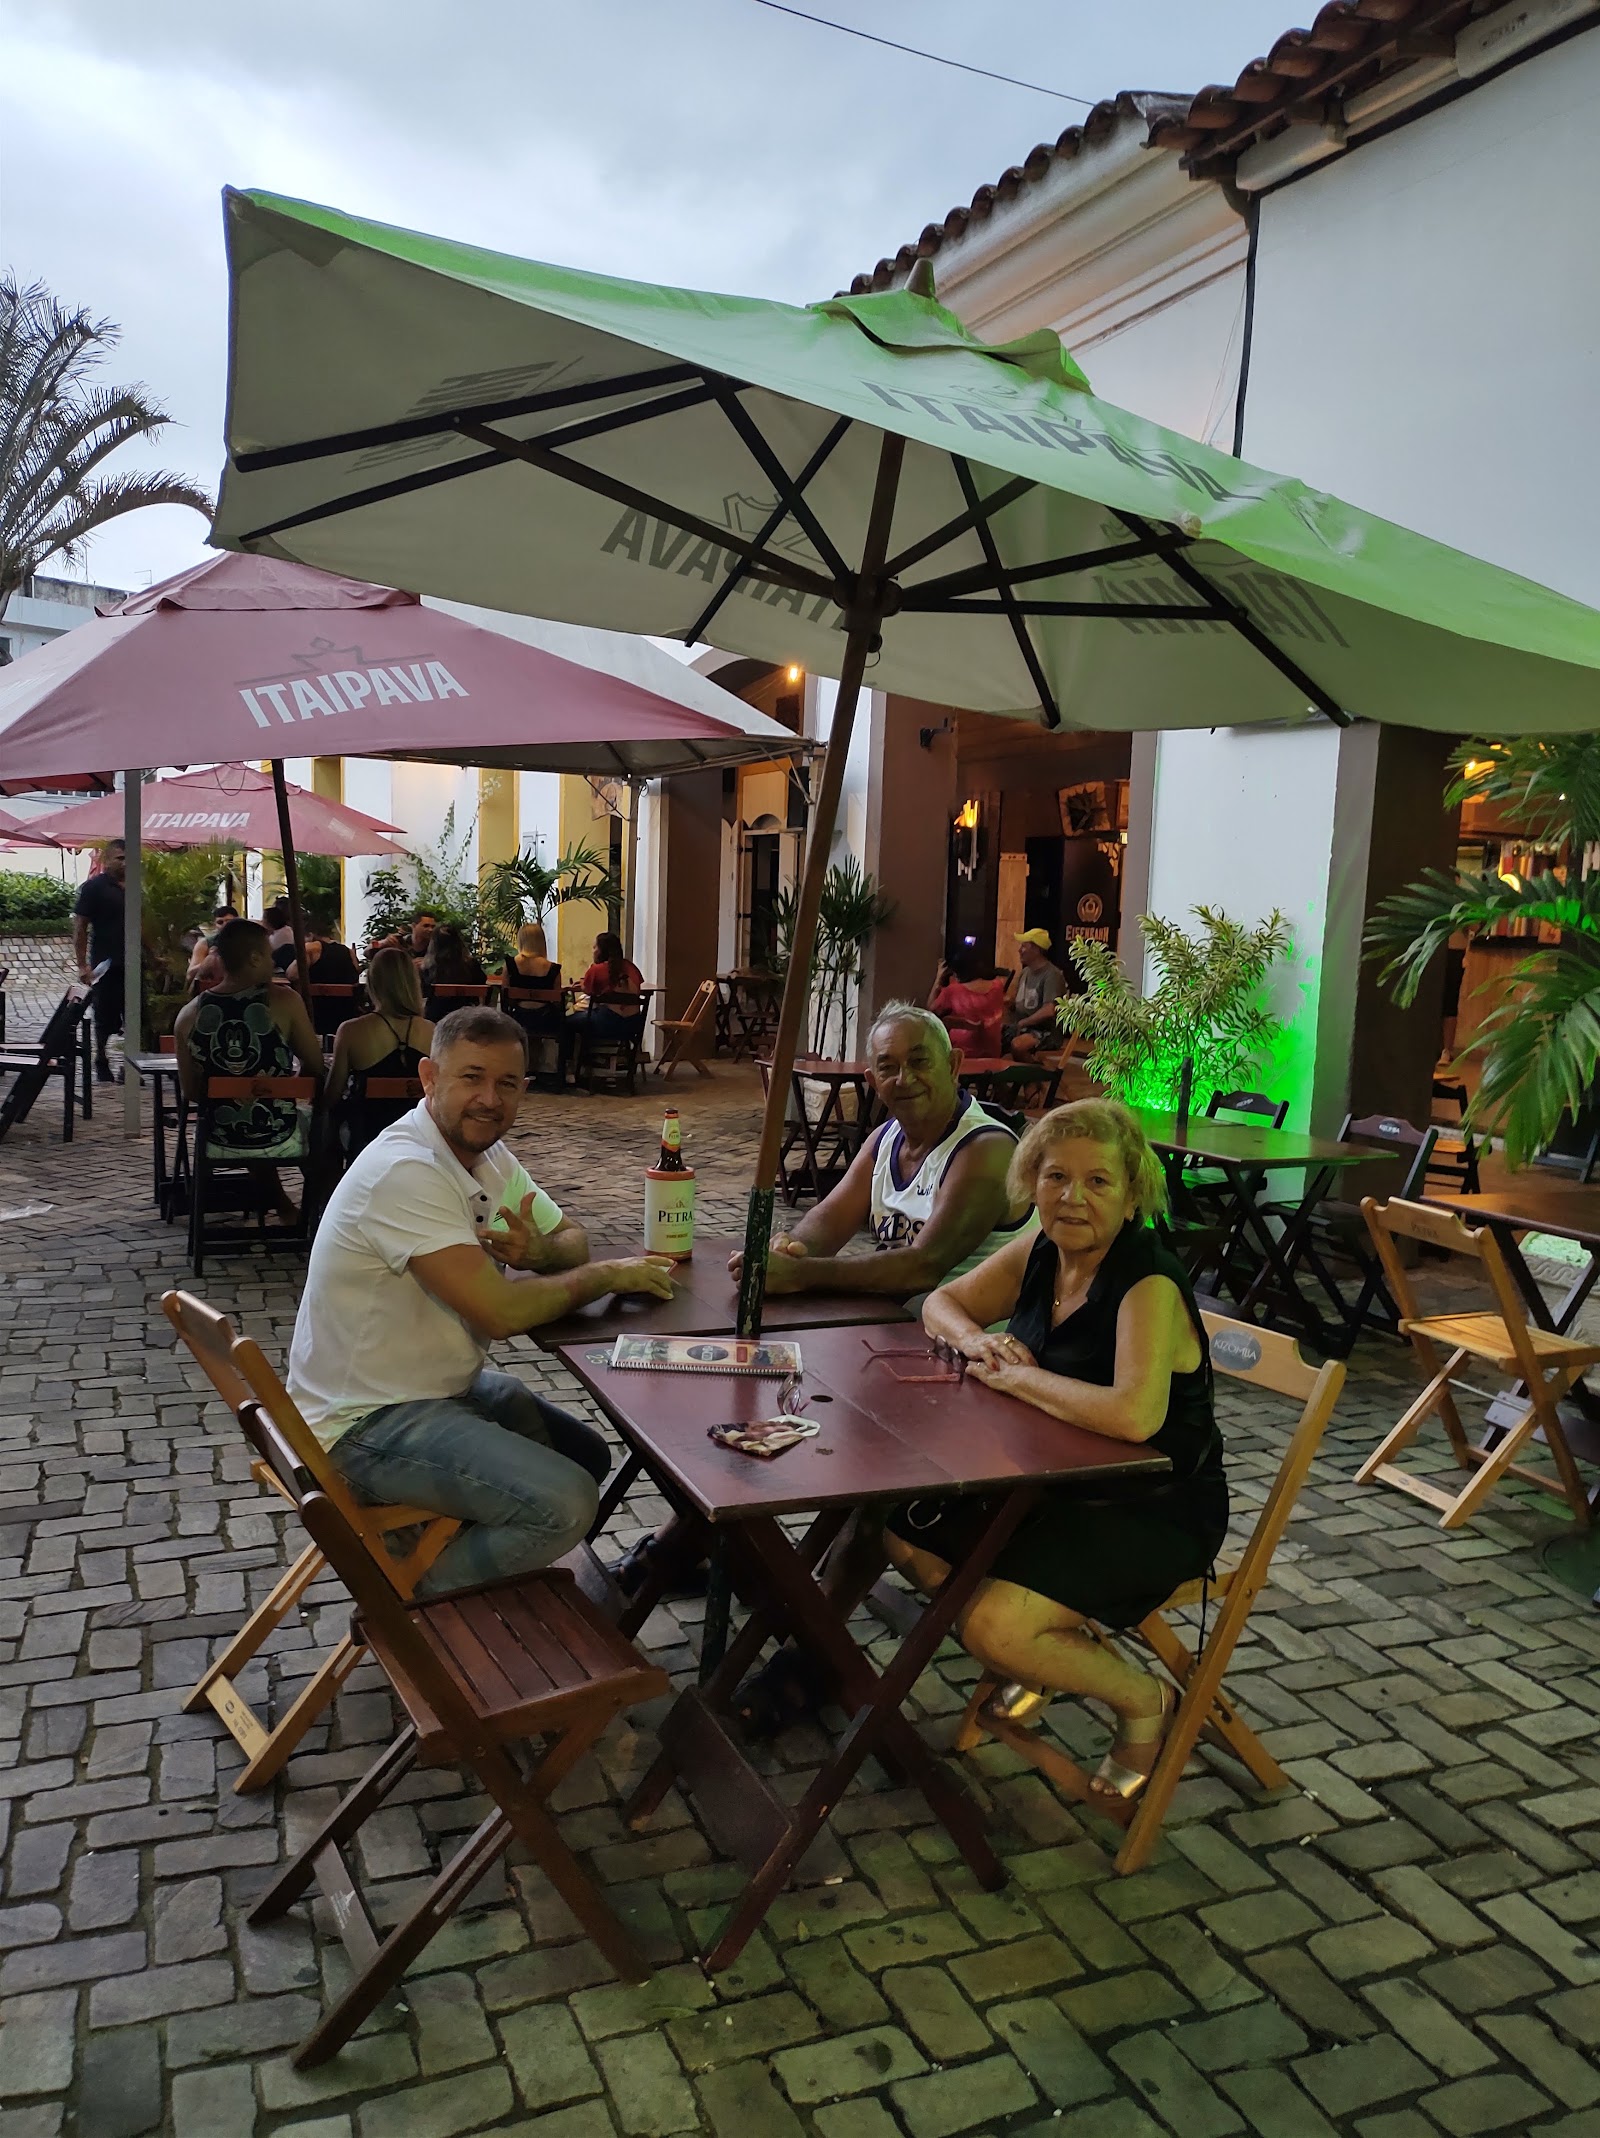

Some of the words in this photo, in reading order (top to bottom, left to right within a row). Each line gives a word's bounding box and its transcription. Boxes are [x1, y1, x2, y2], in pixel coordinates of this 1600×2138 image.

[860, 381, 1265, 502] ITAIPAVA
[239, 661, 470, 728] ITAIPAVA
[143, 812, 251, 828] ITAIPAVA
[658, 1210, 693, 1223] PETRA
